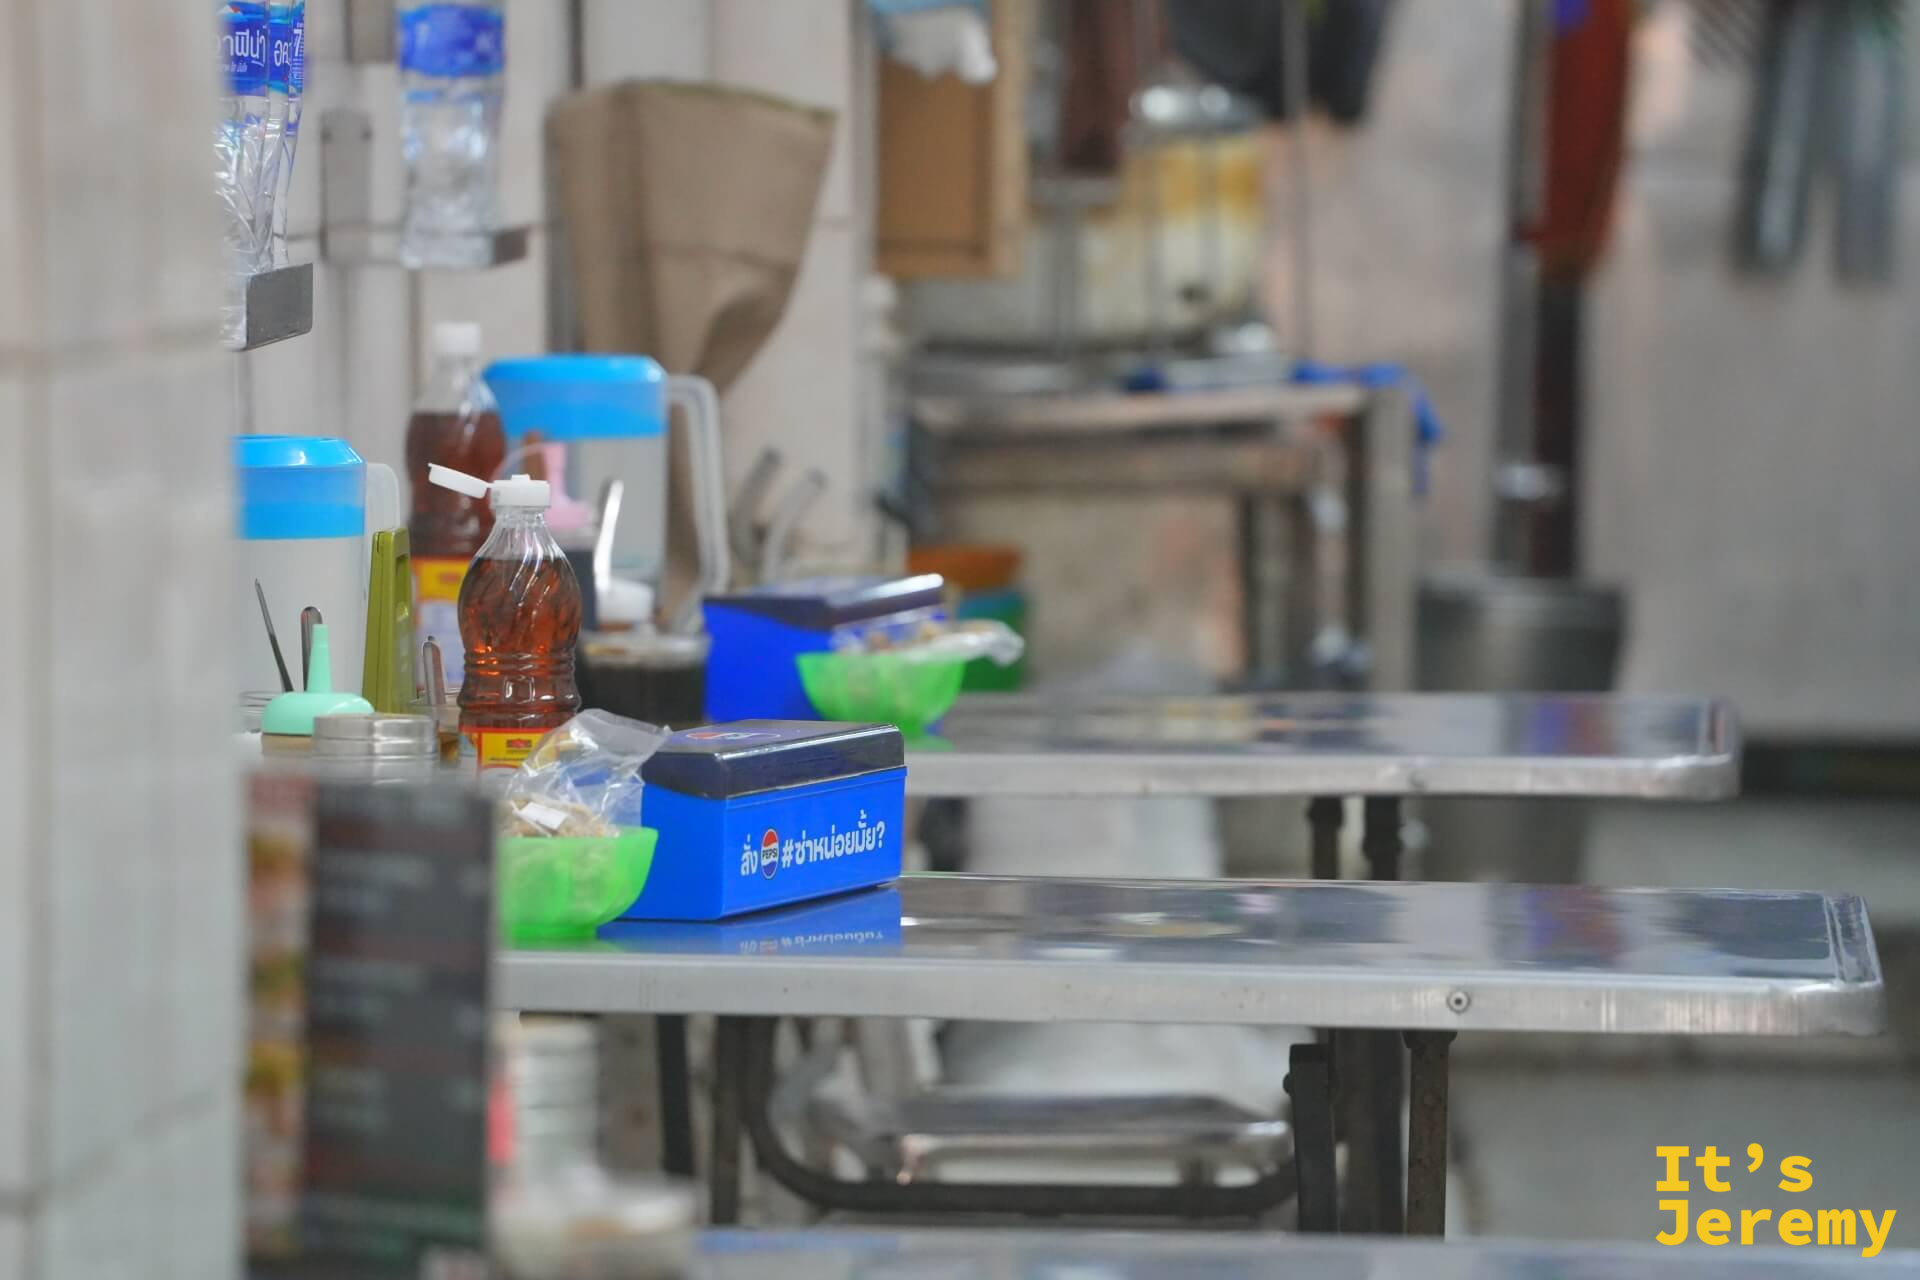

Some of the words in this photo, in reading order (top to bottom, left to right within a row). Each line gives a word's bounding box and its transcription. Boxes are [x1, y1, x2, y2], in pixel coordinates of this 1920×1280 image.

[217, 28, 266, 63] าฟีน่า
[740, 833, 758, 876] สั่ง
[762, 847, 778, 859] PEPSI
[782, 809, 886, 868] #ซ่าหน่อยมั้ย?
